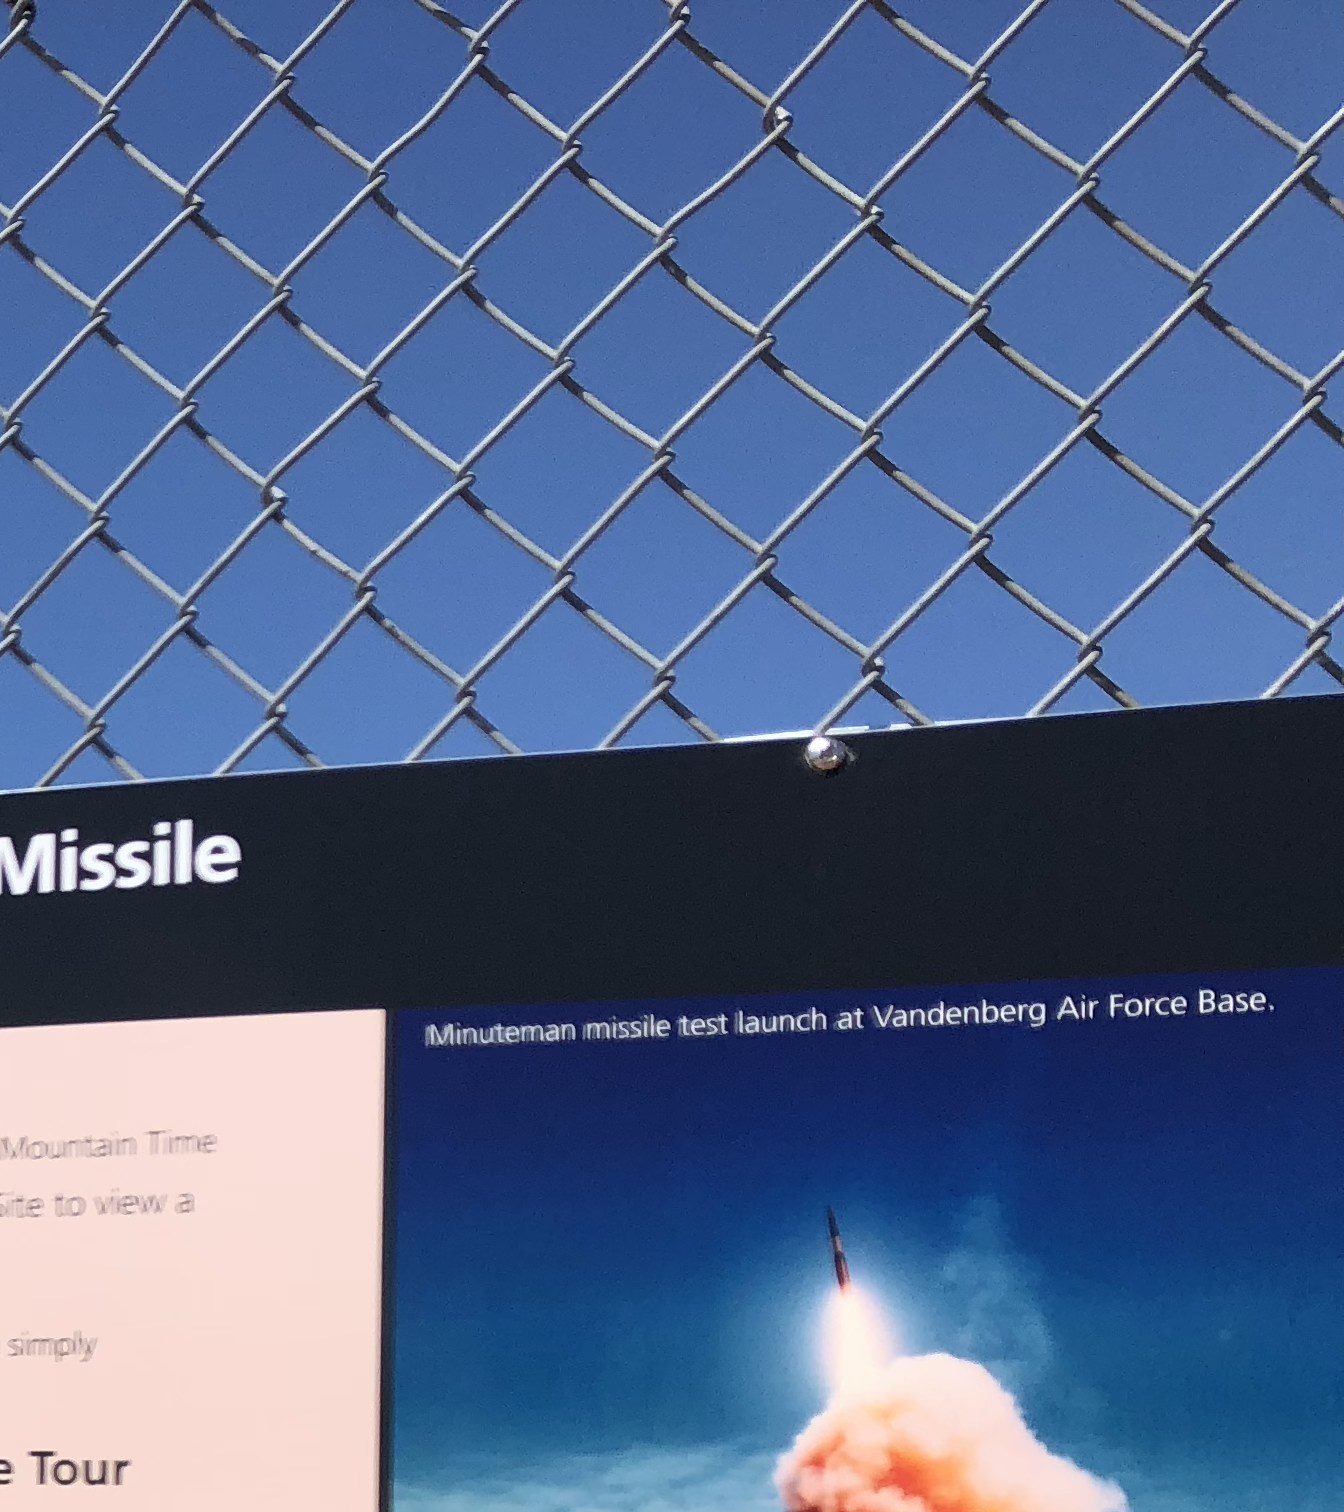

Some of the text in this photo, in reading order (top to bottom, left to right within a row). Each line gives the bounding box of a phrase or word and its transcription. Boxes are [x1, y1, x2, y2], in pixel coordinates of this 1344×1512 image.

[424, 988, 1275, 1047] Minuteman missile test launch at Vandenberg Air Force Base.
[0, 1134, 137, 1161] Mountain
[145, 1129, 218, 1155] Time
[54, 1194, 87, 1219] to
[94, 1188, 168, 1217] view
[174, 1192, 195, 1215] a
[7, 1330, 98, 1364] simply
[27, 1449, 131, 1487] Tour
